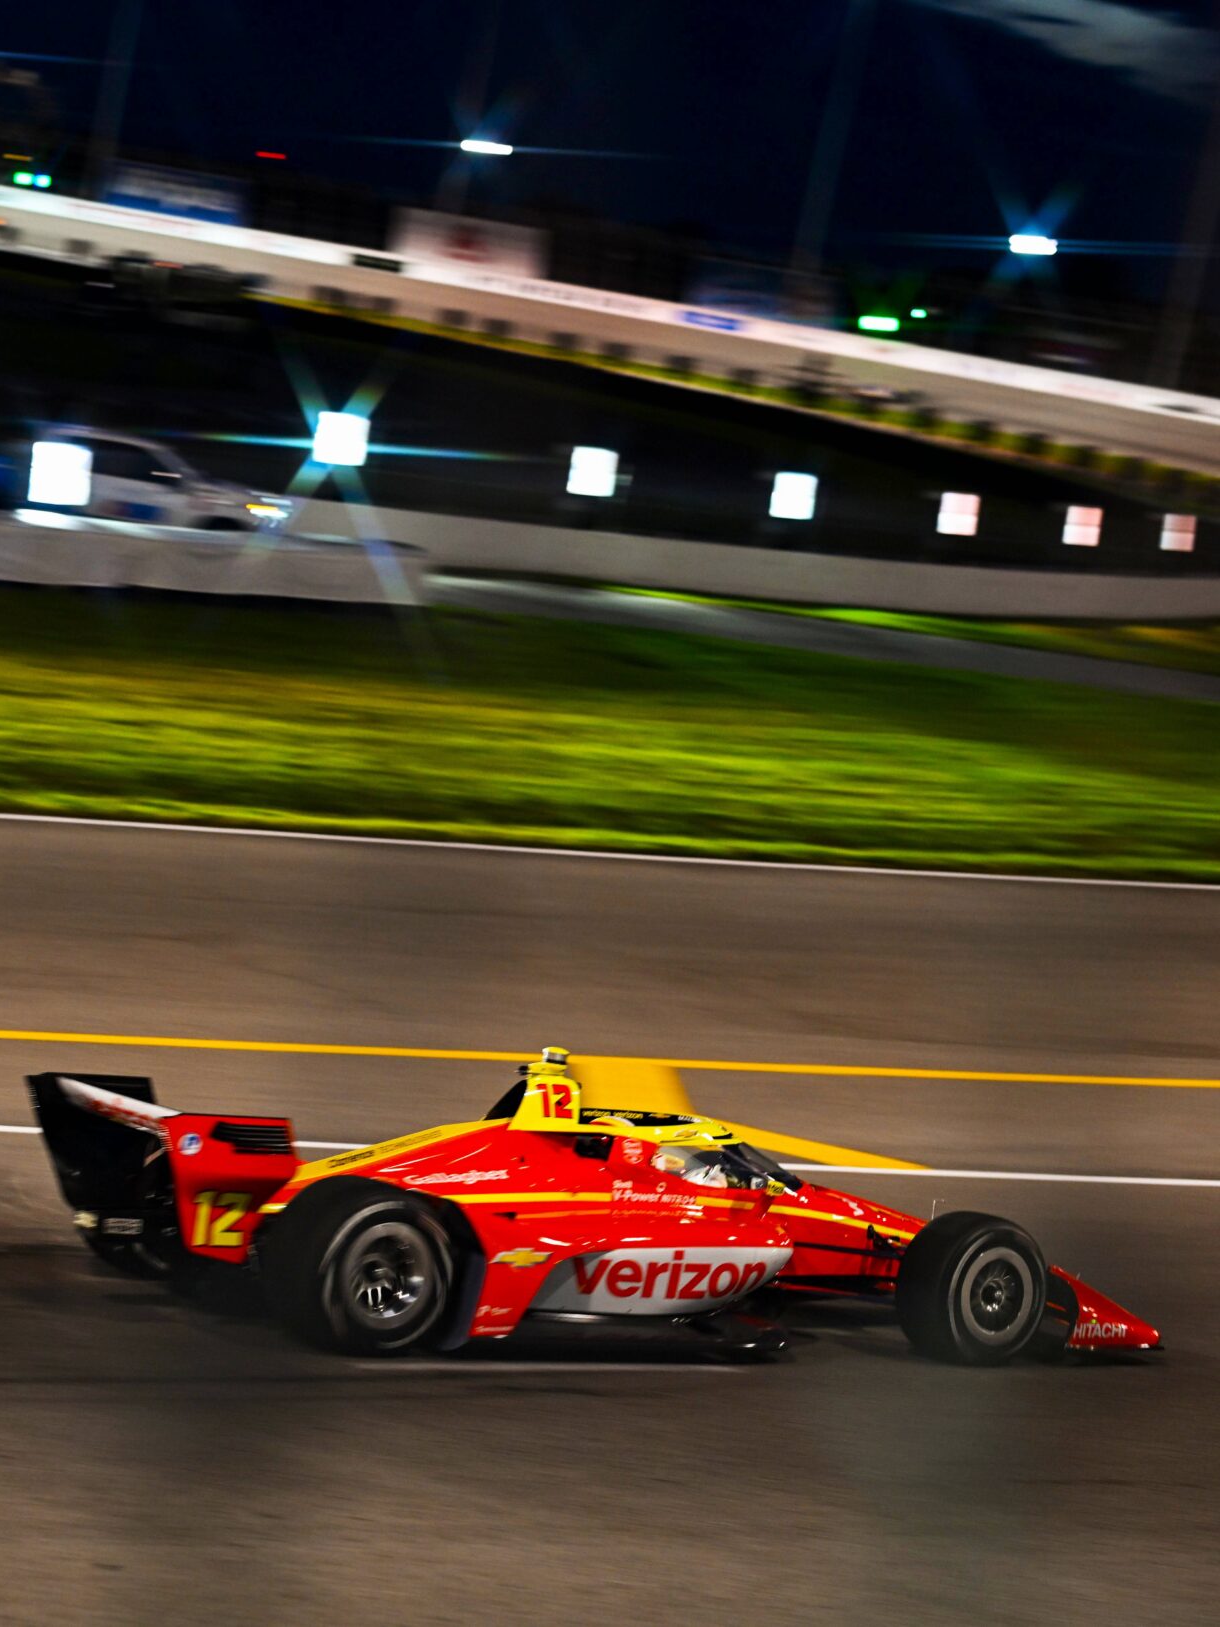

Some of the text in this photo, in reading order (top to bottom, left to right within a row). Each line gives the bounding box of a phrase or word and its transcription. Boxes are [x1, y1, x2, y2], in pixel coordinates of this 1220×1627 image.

[535, 1083, 573, 1119] 12
[582, 1109, 644, 1120] verizon verizon
[612, 1189, 661, 1203] V-Power
[190, 1190, 253, 1247] 12
[573, 1250, 767, 1300] verizon
[1073, 1322, 1127, 1339] HITACHI
